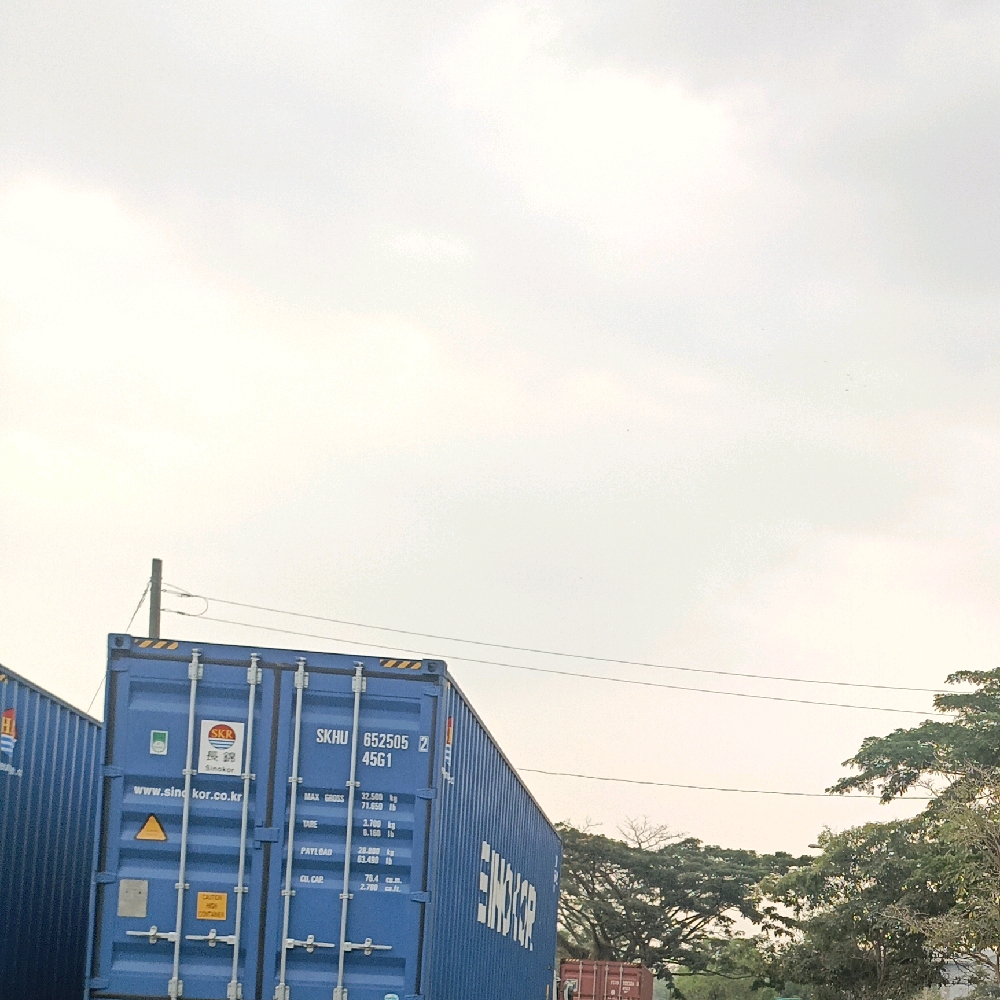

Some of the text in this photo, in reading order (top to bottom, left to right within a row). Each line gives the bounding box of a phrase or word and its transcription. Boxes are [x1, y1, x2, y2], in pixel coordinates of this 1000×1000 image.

[211, 728, 234, 739] SKR
[316, 728, 429, 752] SKHU 652505 2
[362, 751, 392, 768] 45G1
[205, 764, 235, 774] Sinokor
[304, 792, 320, 801] MAX
[302, 819, 318, 829] TARE
[300, 846, 333, 856] PAYLOAD
